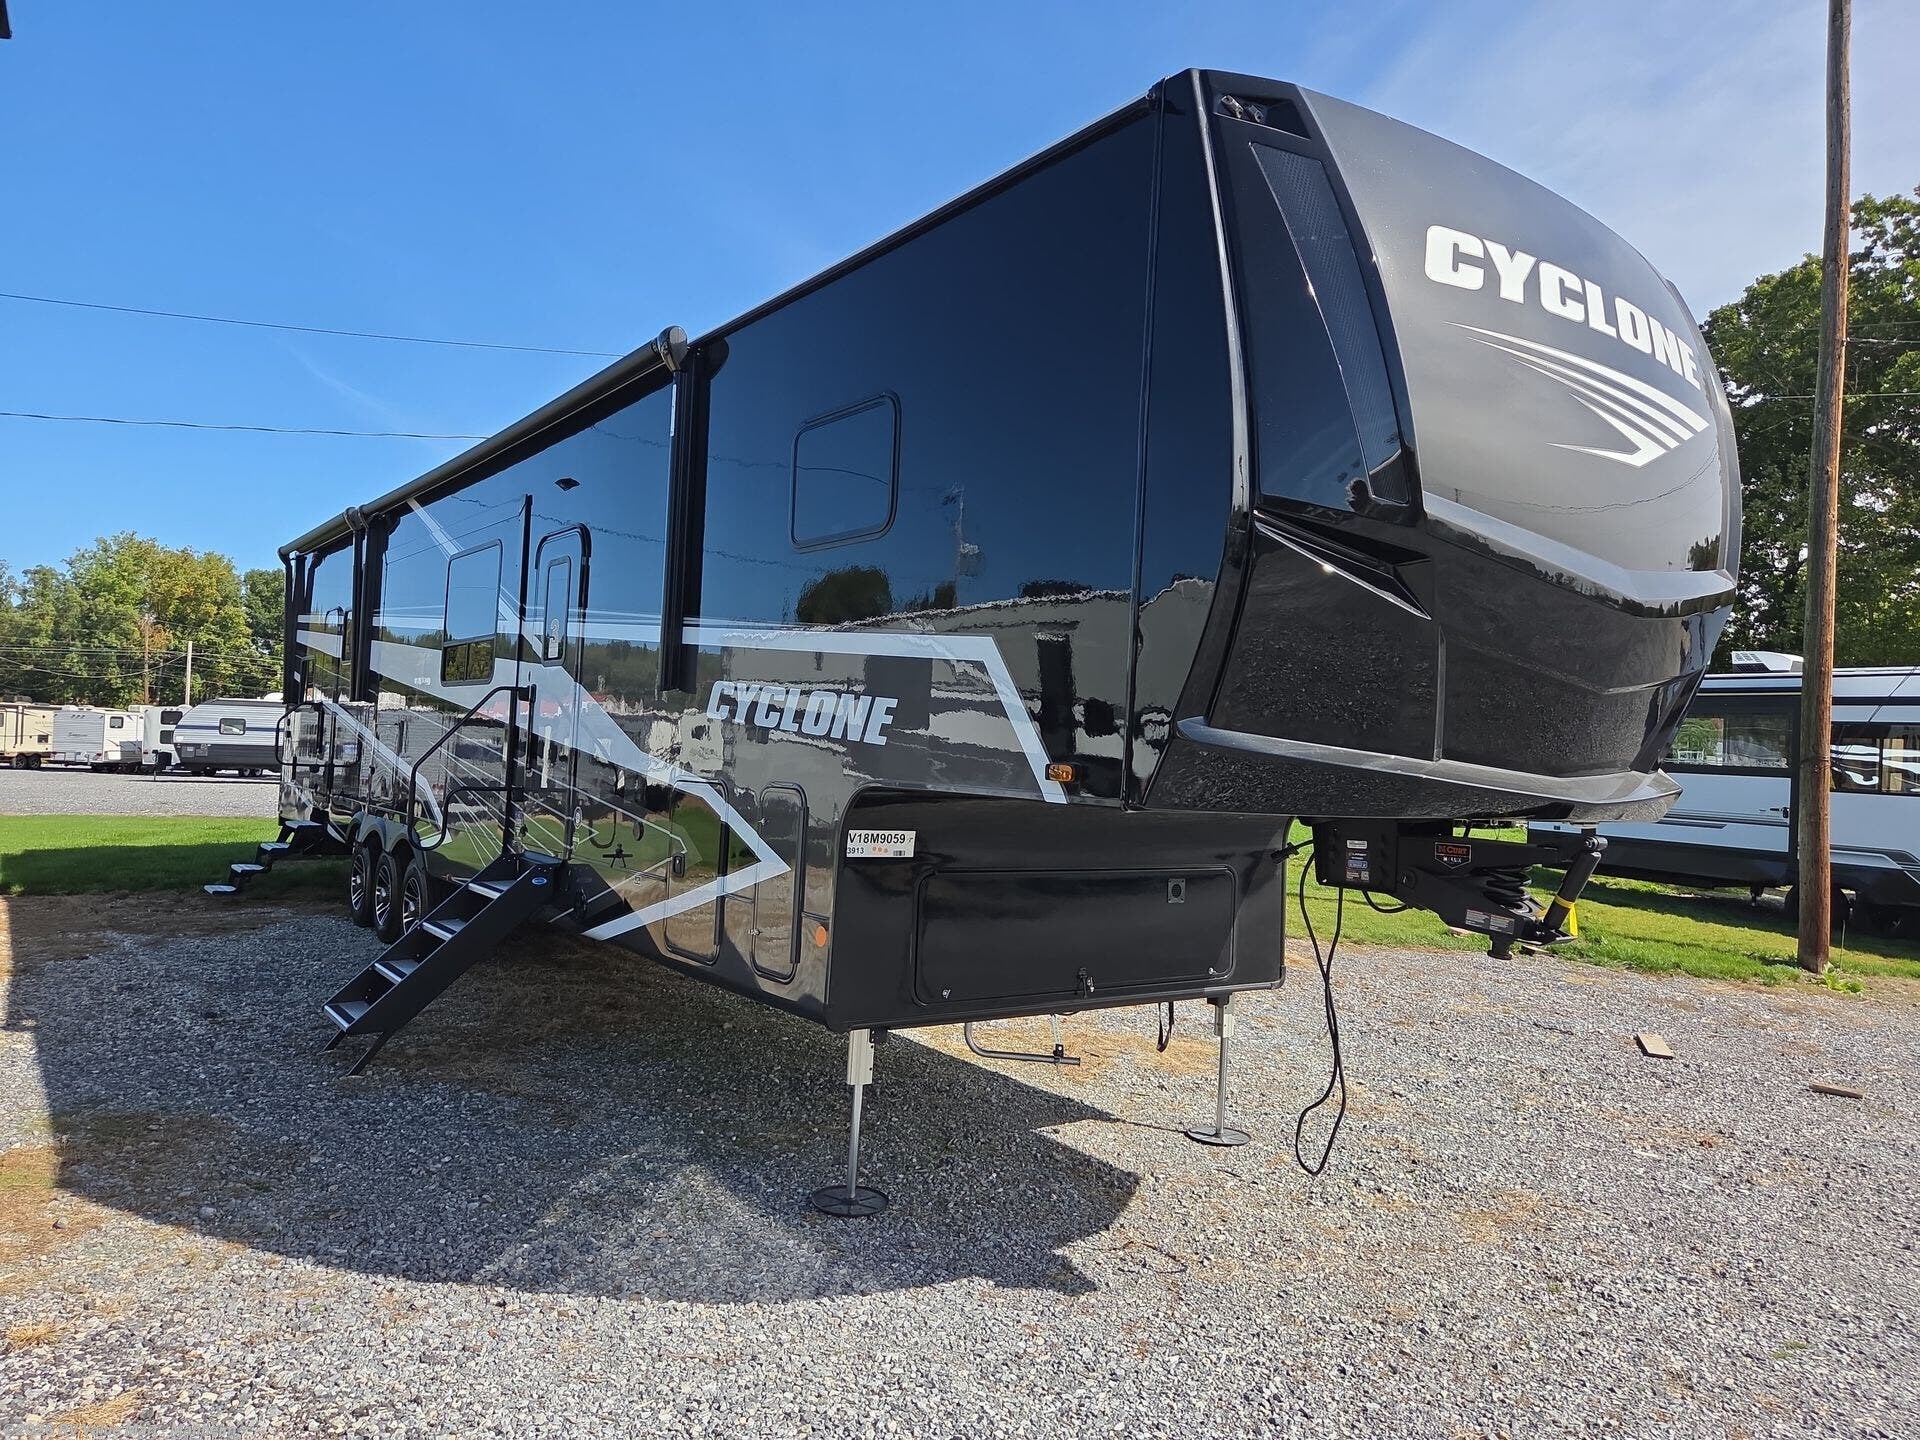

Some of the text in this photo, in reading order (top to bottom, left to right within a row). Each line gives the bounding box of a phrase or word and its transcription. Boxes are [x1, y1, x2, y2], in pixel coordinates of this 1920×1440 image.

[1424, 224, 1701, 391] CYCLONE
[706, 680, 899, 746] CYCLONE
[847, 846, 865, 855] 3913
[848, 832, 906, 844] V18M9059
